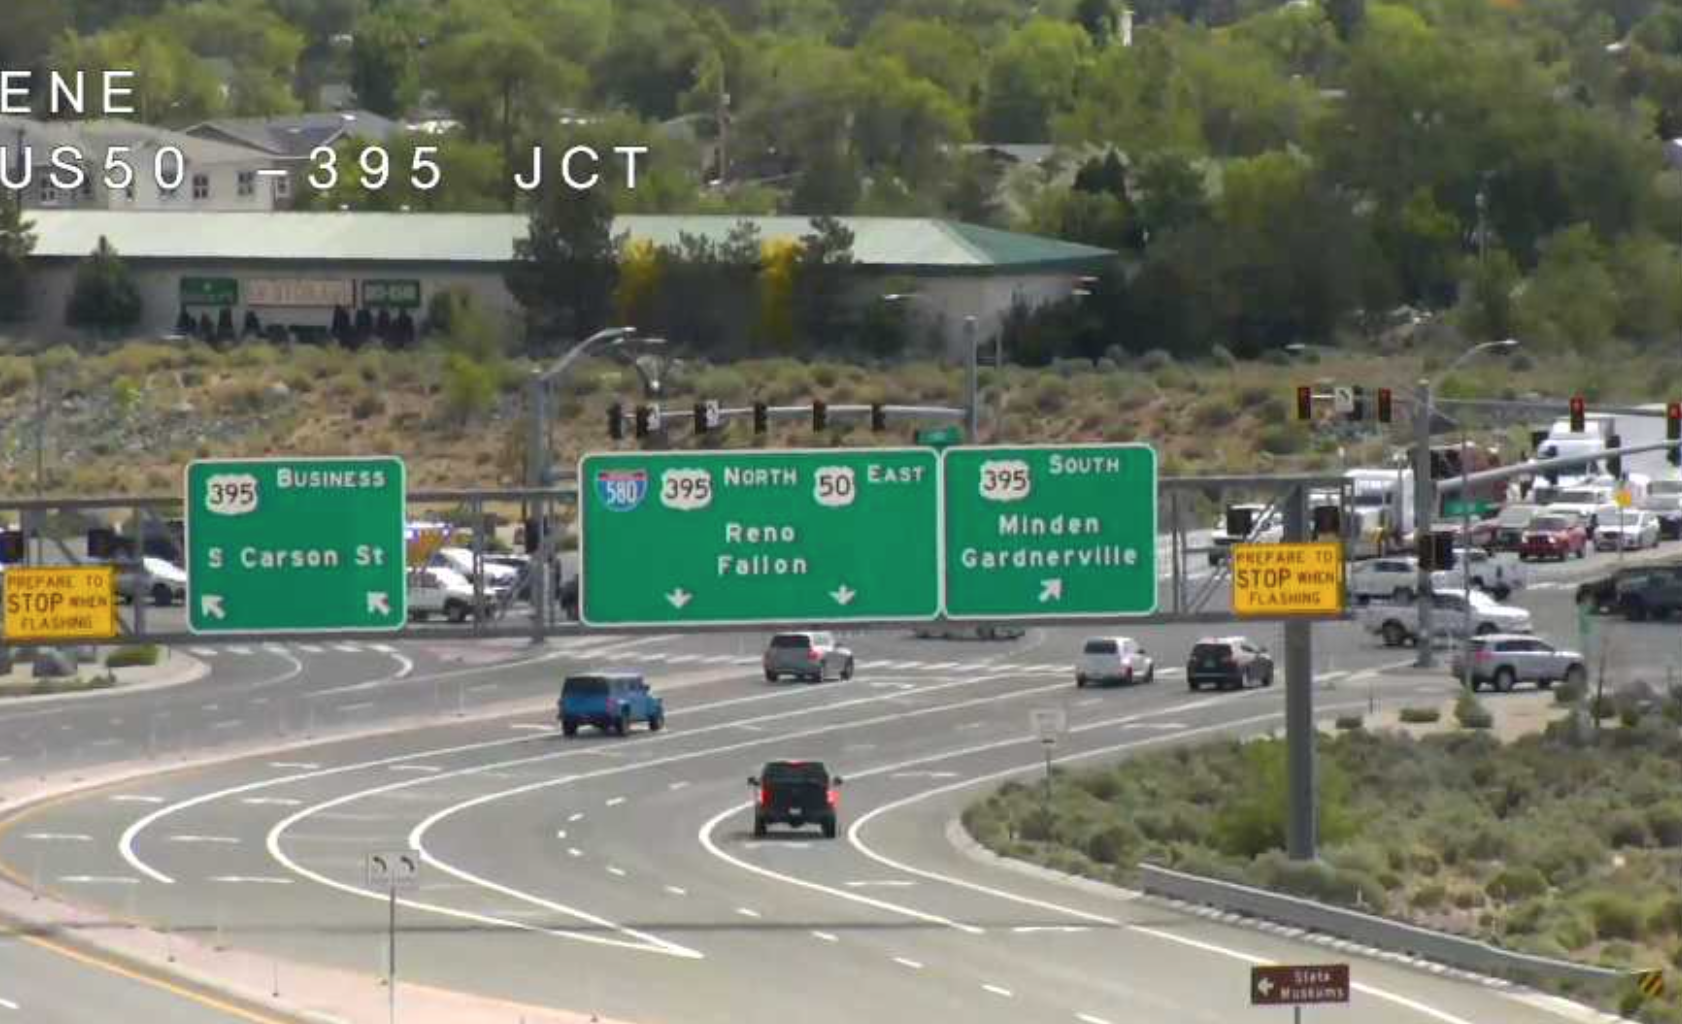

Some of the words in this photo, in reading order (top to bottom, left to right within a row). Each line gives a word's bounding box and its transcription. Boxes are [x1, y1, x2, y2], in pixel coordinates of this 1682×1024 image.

[984, 469, 1028, 491] 395
[1049, 455, 1120, 475] SOUTH
[209, 483, 256, 505] 395
[277, 468, 386, 488] BUSINESS
[606, 480, 638, 505] 580
[665, 478, 709, 501] 395
[724, 467, 798, 487] NORTH
[819, 475, 851, 498] 50
[868, 465, 924, 483] EAST
[726, 523, 796, 544] Reno
[998, 513, 1101, 535] Minden
[208, 548, 223, 568] S
[241, 547, 339, 569] Carson
[356, 545, 385, 566] St
[718, 556, 808, 576] Fallon
[961, 546, 1138, 569] Gardnerville
[1236, 550, 1305, 564] PREPARE
[1316, 550, 1333, 563] TO
[7, 574, 76, 588] PREPARE
[87, 574, 104, 587] TO
[1236, 568, 1291, 589] STOP
[1297, 572, 1335, 584] WHEN
[8, 592, 63, 614] STOP
[70, 596, 107, 608] WHEN
[1250, 591, 1321, 605] FLASHING
[20, 617, 93, 630] FLASHING
[1294, 969, 1330, 983] State
[1280, 986, 1345, 1001] Museums
